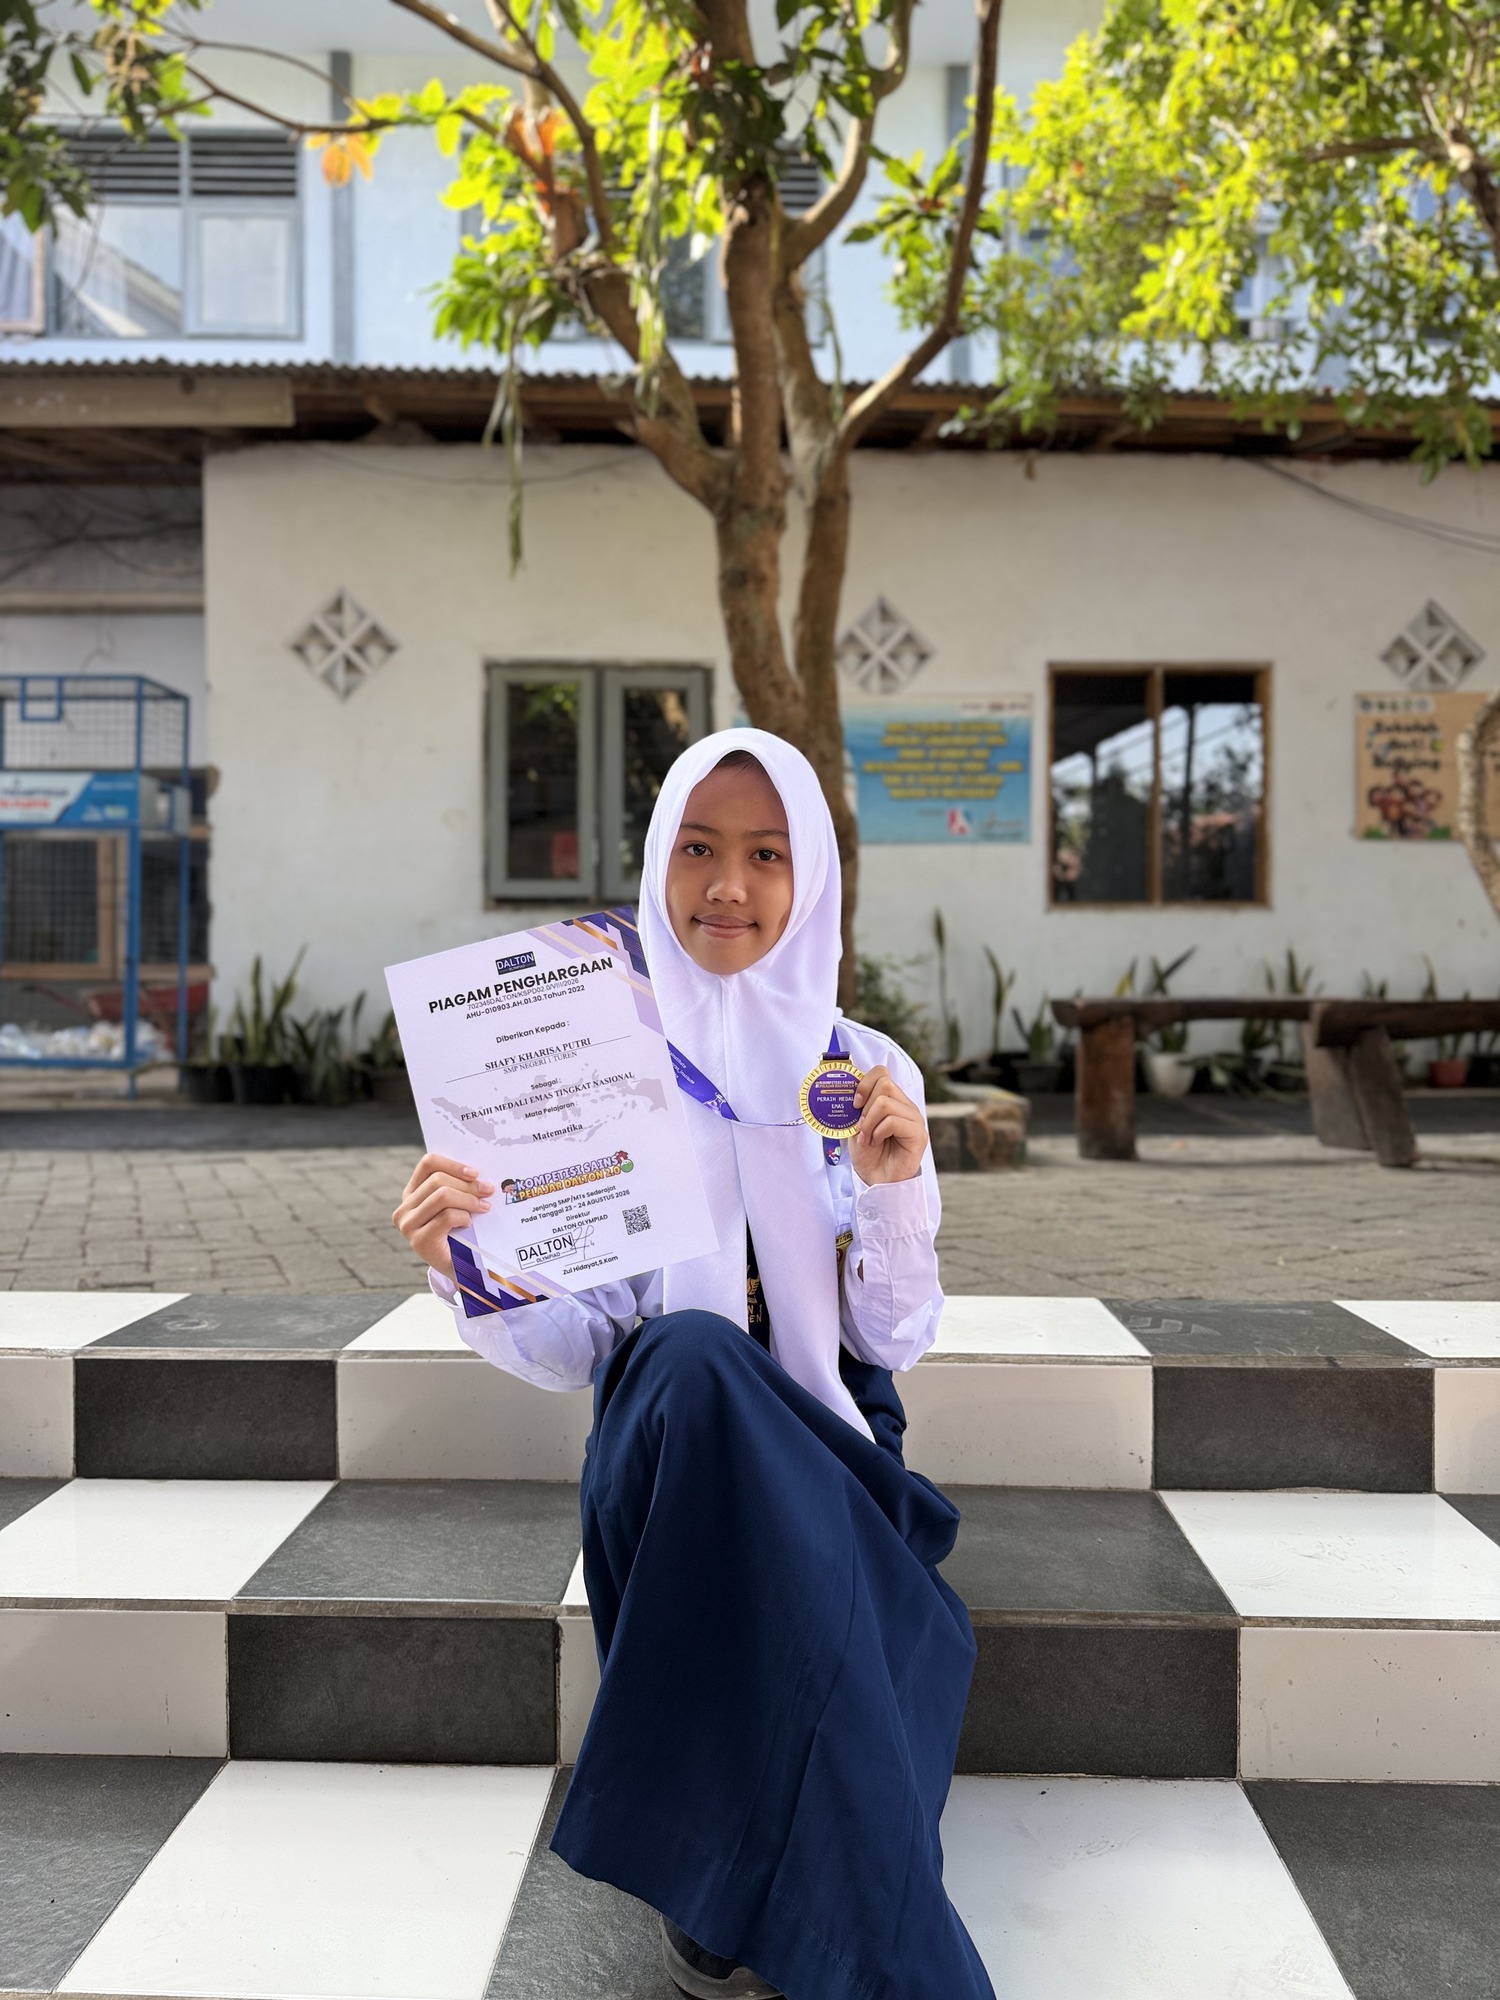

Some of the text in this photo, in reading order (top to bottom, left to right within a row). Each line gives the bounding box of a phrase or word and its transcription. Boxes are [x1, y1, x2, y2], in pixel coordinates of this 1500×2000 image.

[497, 953, 534, 970] DALTON
[428, 957, 613, 1013] PIAGAM PENGHARGAAN
[567, 984, 585, 995] 2022
[496, 1029, 534, 1043] Diberikan
[485, 1038, 591, 1070] SHAFY KHARISA PUTRI
[503, 1065, 519, 1074] SMP
[520, 1057, 547, 1070] NEGERI
[553, 1051, 578, 1061] TUREN
[461, 1071, 635, 1121] PERAIH MEDALI EMAS TINGKAT NASIONAL
[525, 1109, 542, 1118] Mata
[543, 1101, 575, 1114] Pelajaran
[532, 1123, 583, 1141] Matematika
[516, 1154, 618, 1191] KOMPETISI SAINS
[518, 1165, 621, 1200] PELAJAR DALTON 2.0
[521, 1213, 538, 1224] Pada
[538, 1208, 564, 1221] Tanggal
[578, 1201, 587, 1209] 24
[587, 1194, 615, 1207] AGUSTUS
[532, 1185, 616, 1213] Jenjang SMP/MTs Sederajat
[552, 1214, 608, 1234] DALTON OLYMPIAD
[566, 1210, 591, 1222] Direktur
[518, 1235, 573, 1262] DALTON
[536, 1252, 561, 1263] OLYMPIAD
[563, 1267, 573, 1275] Zul
